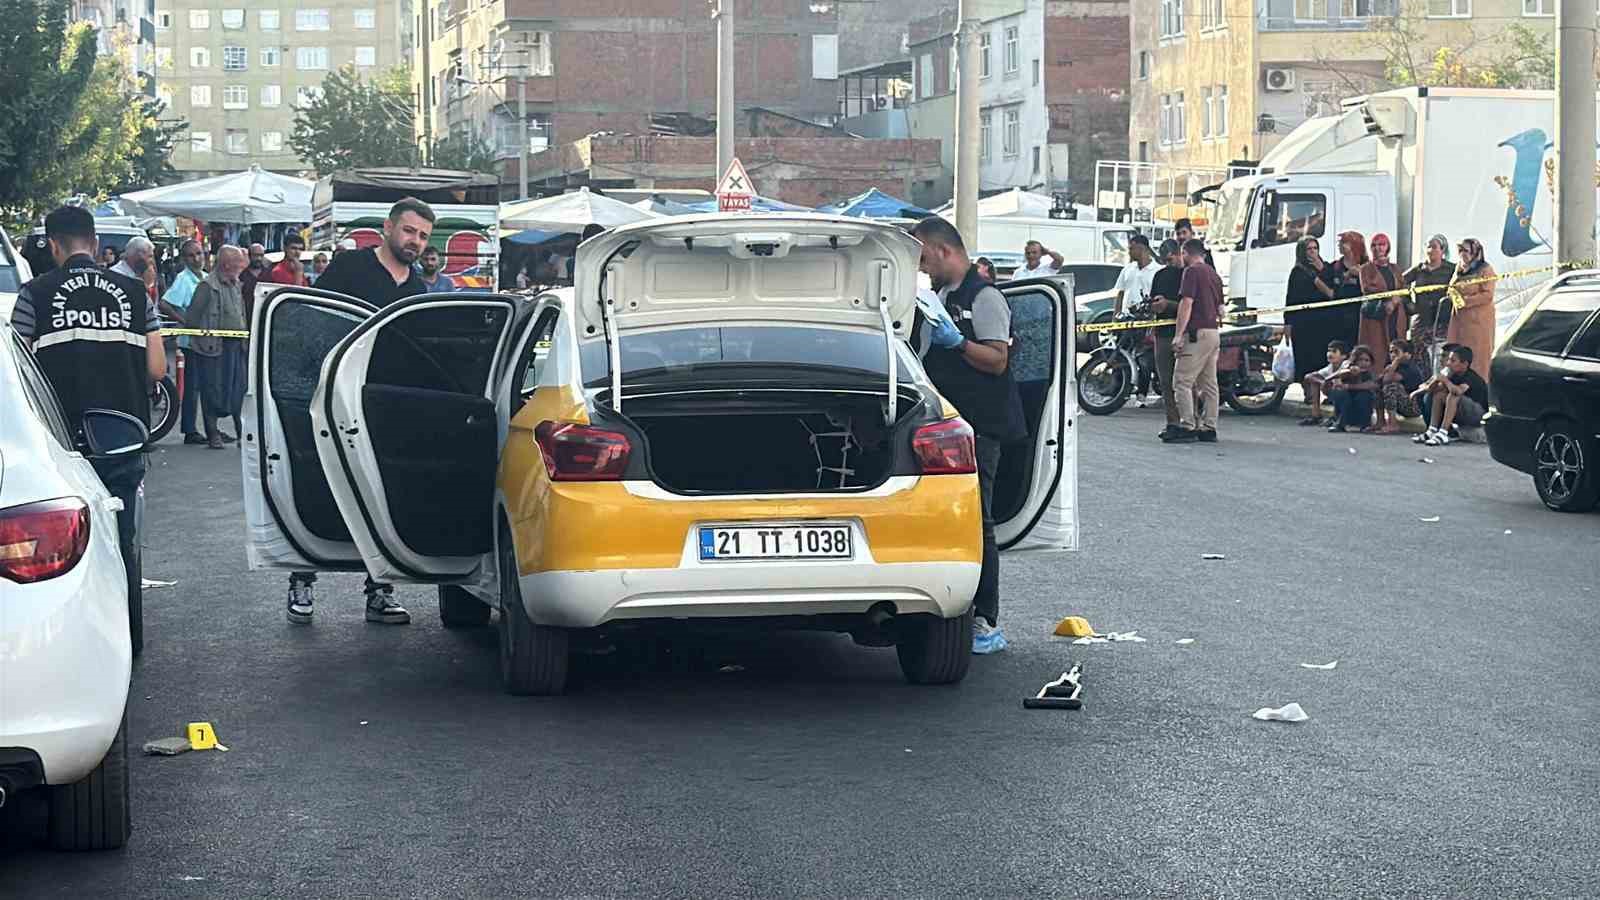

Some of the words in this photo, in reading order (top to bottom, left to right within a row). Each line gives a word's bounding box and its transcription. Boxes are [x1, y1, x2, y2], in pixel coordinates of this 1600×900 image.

[52, 291, 68, 328] OLAY
[65, 306, 121, 328] POLİS
[718, 531, 741, 555] 21
[757, 530, 783, 554] TT
[794, 530, 847, 553] 1038
[197, 729, 204, 741] 7
